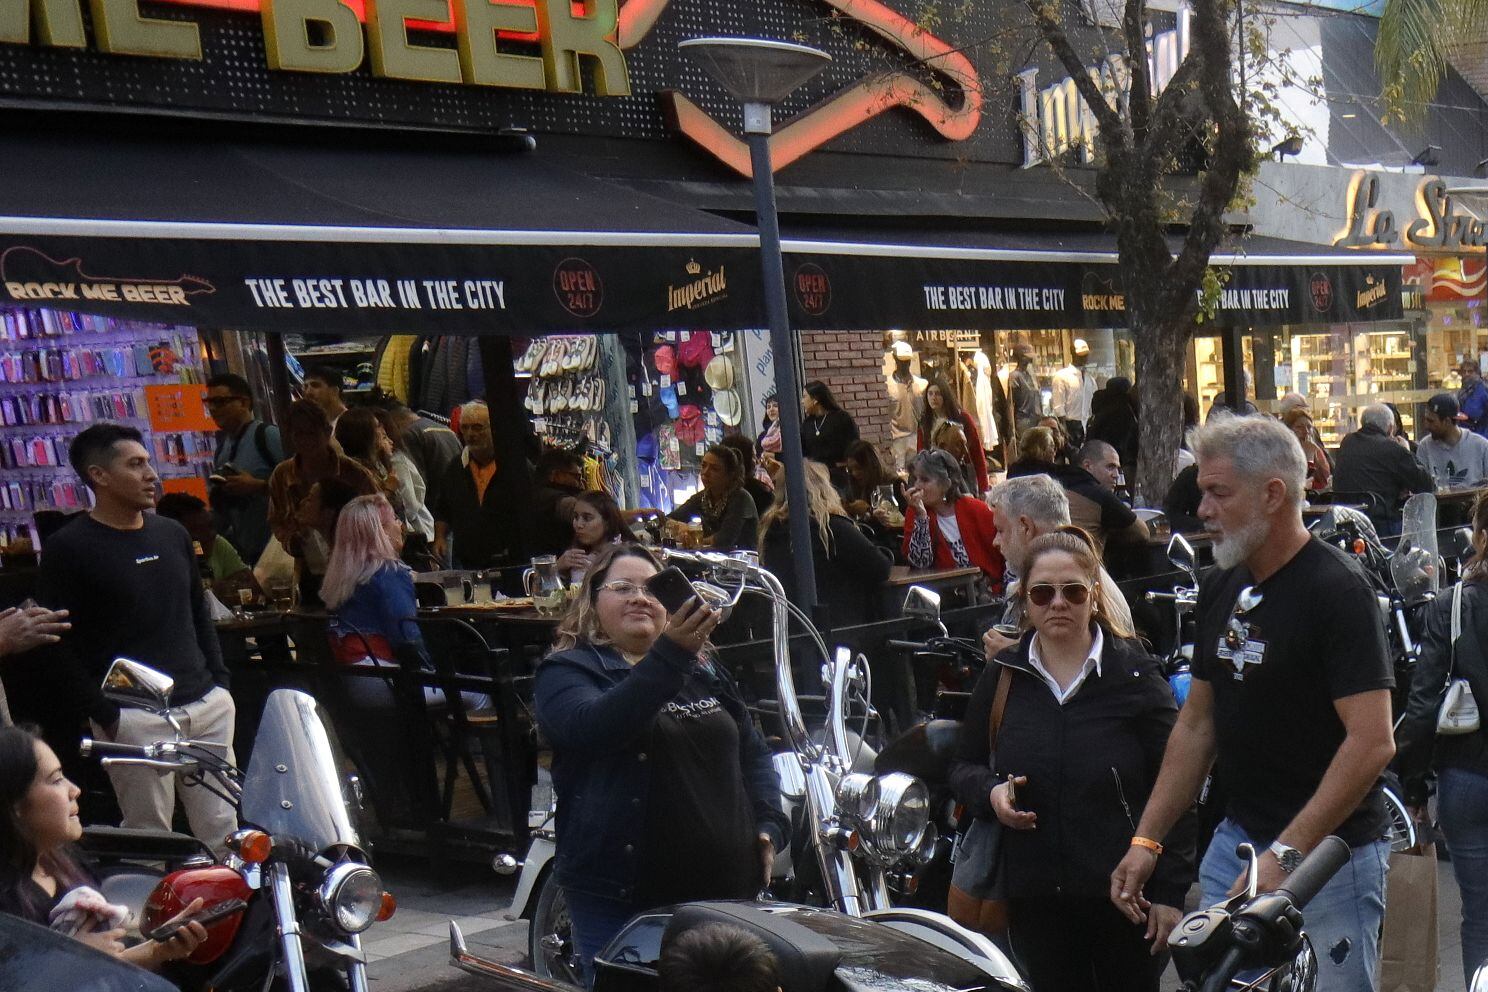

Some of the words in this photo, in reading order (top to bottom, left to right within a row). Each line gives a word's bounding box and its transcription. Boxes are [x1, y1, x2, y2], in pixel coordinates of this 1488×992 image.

[1332, 170, 1399, 248] La
[559, 270, 596, 292] OPEN
[667, 265, 728, 313] Imperial
[798, 273, 826, 293] OPEN
[5, 281, 80, 300] ROCK
[79, 283, 123, 302] ME
[120, 285, 191, 306] BEER
[245, 278, 295, 308] THE
[292, 279, 348, 309] BEST
[350, 279, 397, 309] BAR
[397, 280, 422, 310] IN
[422, 280, 464, 310] THE
[464, 281, 506, 310] CITY
[567, 293, 594, 310] 24/7
[803, 294, 823, 309] 24/7
[923, 286, 946, 310] THE
[948, 287, 979, 310] BEST
[979, 287, 1003, 311] BAR
[1004, 287, 1017, 311] IN
[1018, 287, 1041, 311] THE
[1043, 288, 1066, 312] CITY
[1081, 294, 1109, 311] ROCK
[1108, 295, 1126, 311] ME
[1221, 289, 1240, 310] BAR
[1240, 290, 1251, 310] IN
[1251, 289, 1271, 310] THE
[1270, 289, 1289, 310] CITY
[1356, 279, 1387, 310] Imperial
